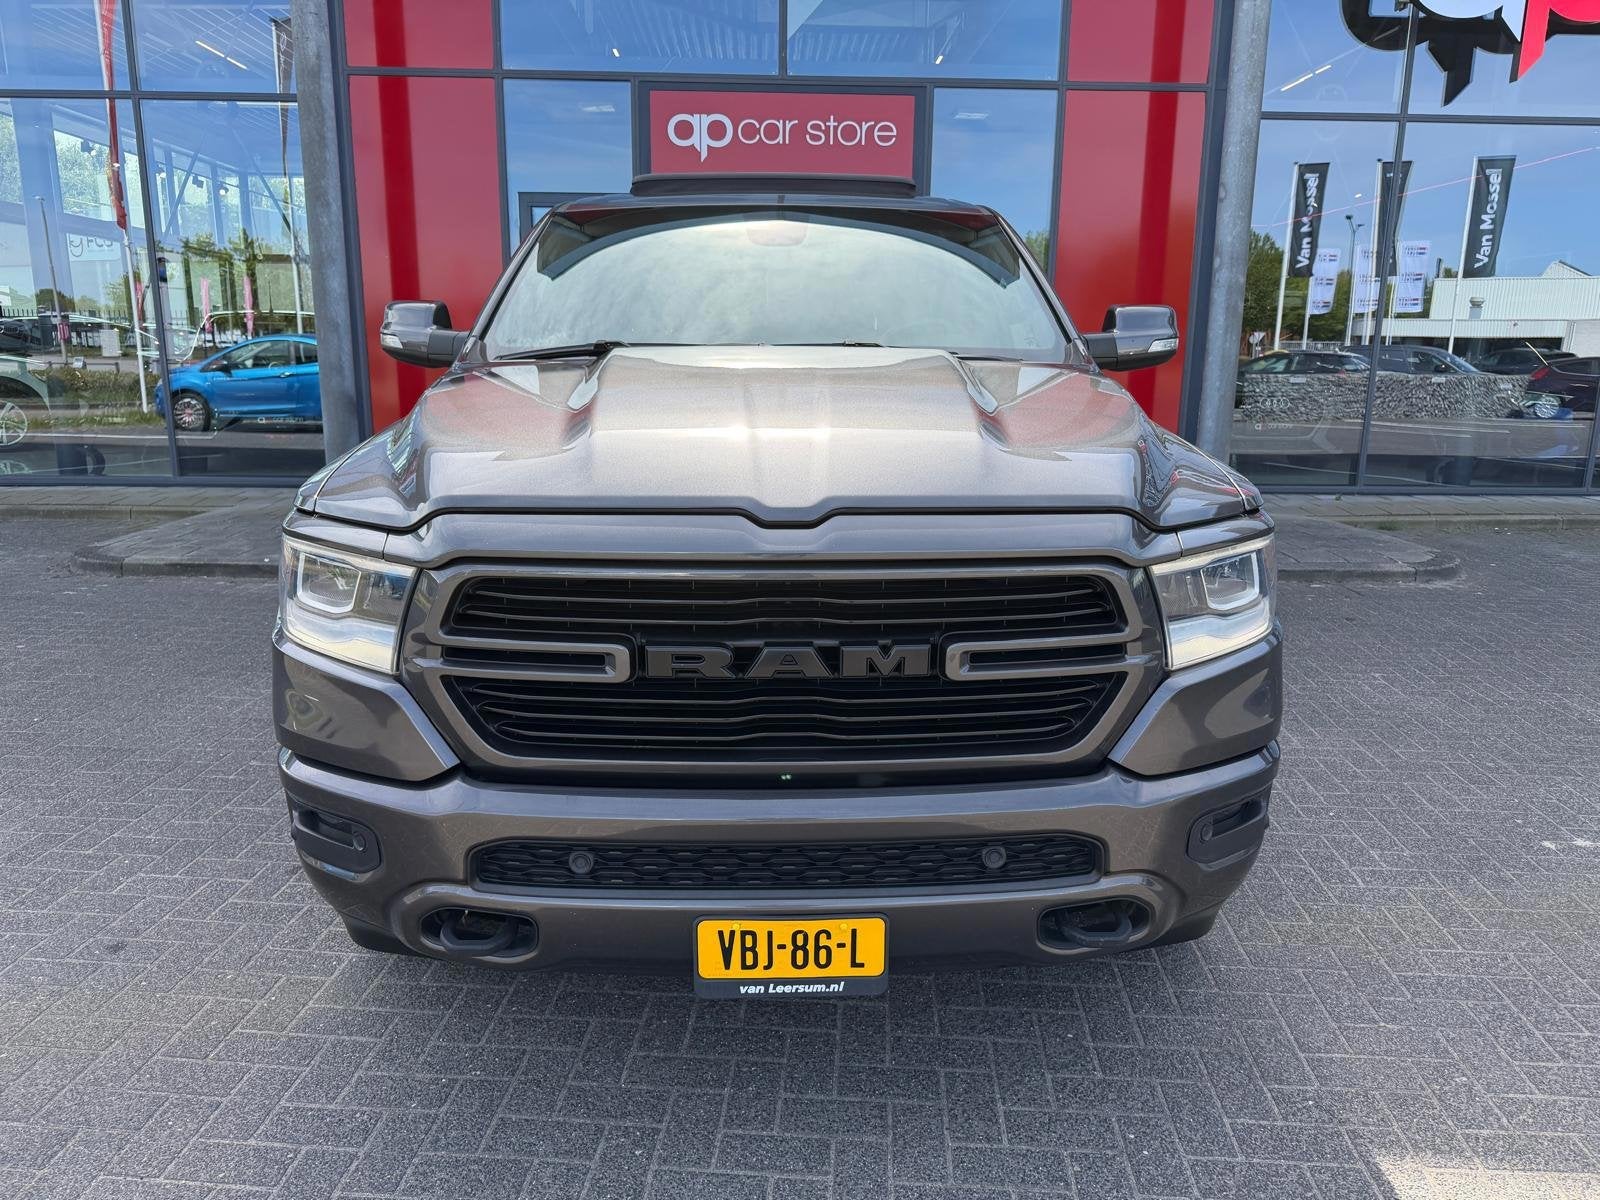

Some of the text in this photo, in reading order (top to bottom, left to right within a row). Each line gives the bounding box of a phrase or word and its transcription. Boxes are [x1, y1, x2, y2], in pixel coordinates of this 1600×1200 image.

[738, 119, 798, 144] car
[805, 115, 897, 147] store
[1474, 168, 1502, 268] Van Mossel
[1295, 237, 1312, 268] Van
[645, 645, 931, 678] RAM
[717, 928, 865, 971] VBJ-86-L
[739, 981, 845, 994] van Leersum.nl
